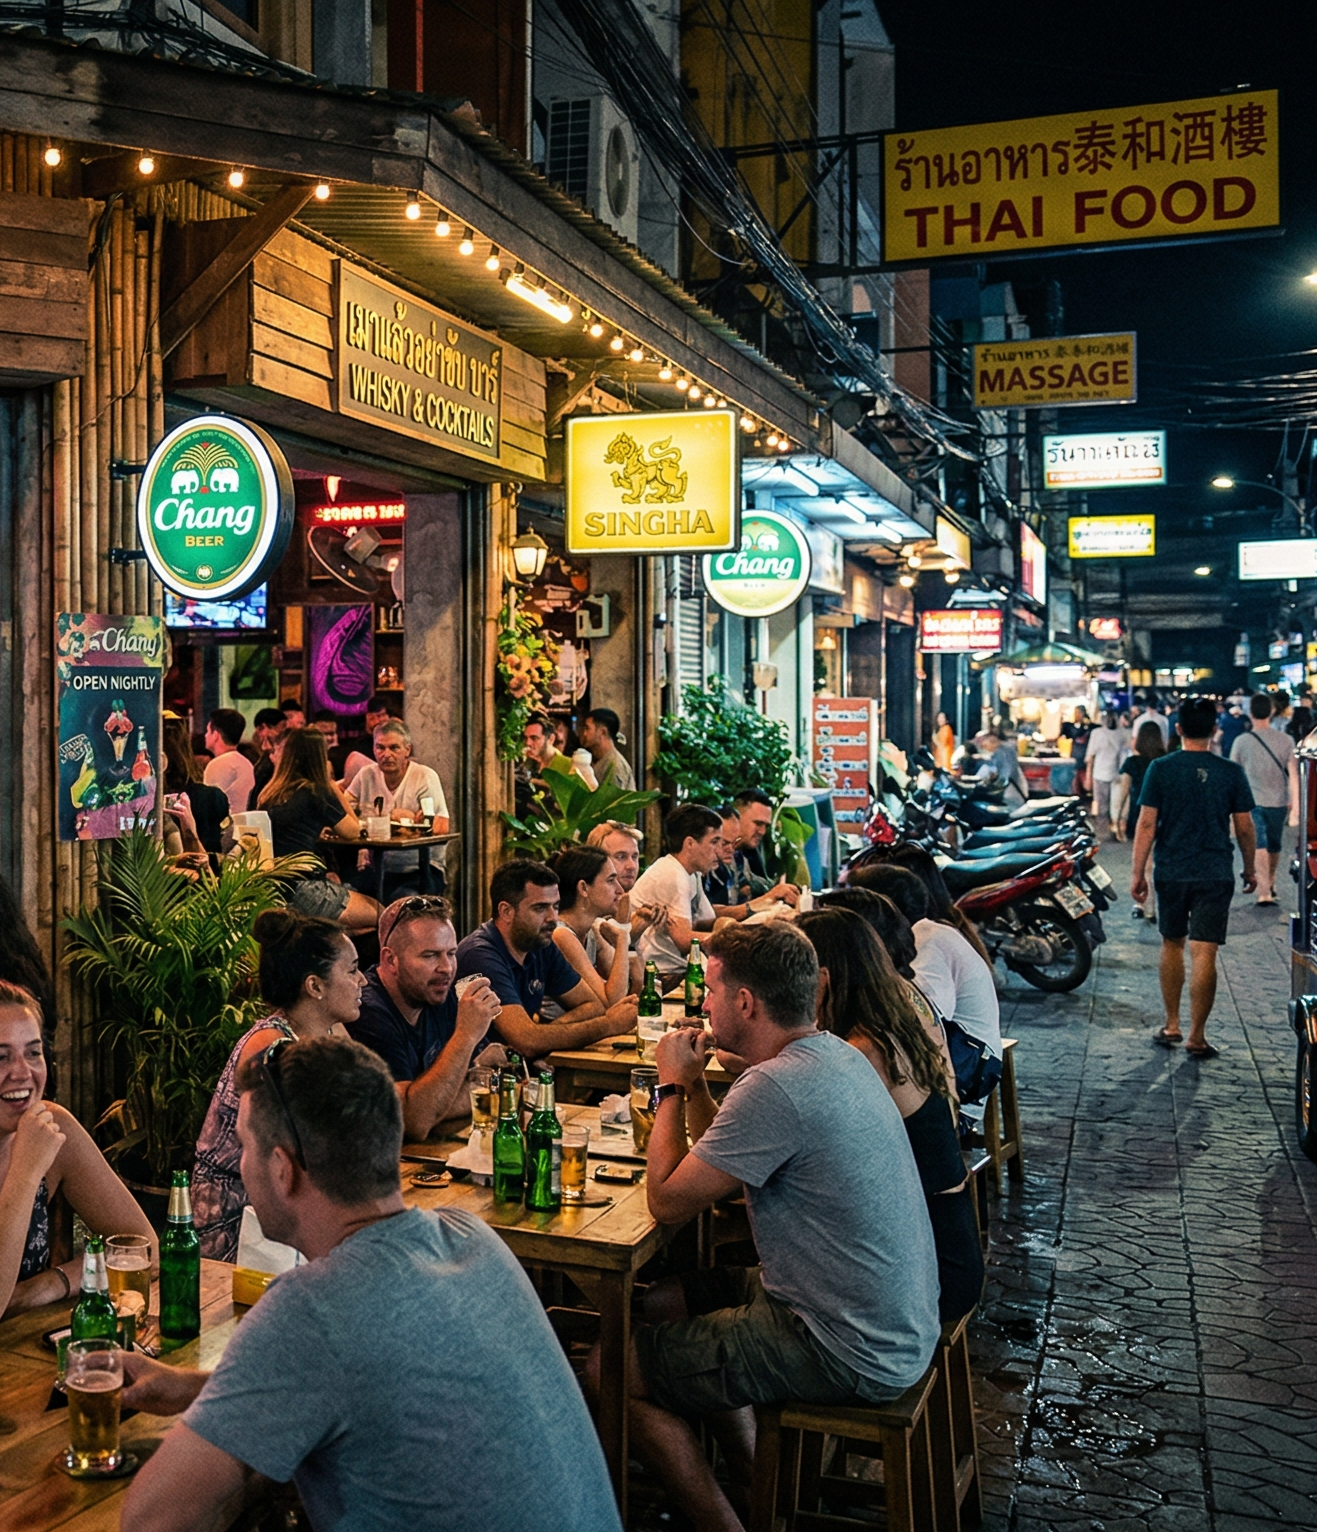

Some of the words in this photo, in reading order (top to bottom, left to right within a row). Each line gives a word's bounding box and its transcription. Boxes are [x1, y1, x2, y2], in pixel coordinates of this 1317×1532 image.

[904, 196, 1044, 248] THAI
[1074, 175, 1257, 234] FOOD
[980, 360, 1129, 393] MASSAGE
[350, 362, 411, 418] WHISKY
[412, 388, 424, 424] &
[426, 392, 495, 449] COCKTAILS
[154, 498, 256, 536] Chang
[584, 509, 715, 538] SINGHA
[185, 535, 224, 547] BEER
[715, 551, 795, 580] Chang
[73, 675, 108, 690] OPEN
[110, 675, 156, 690] NIGHTLY
